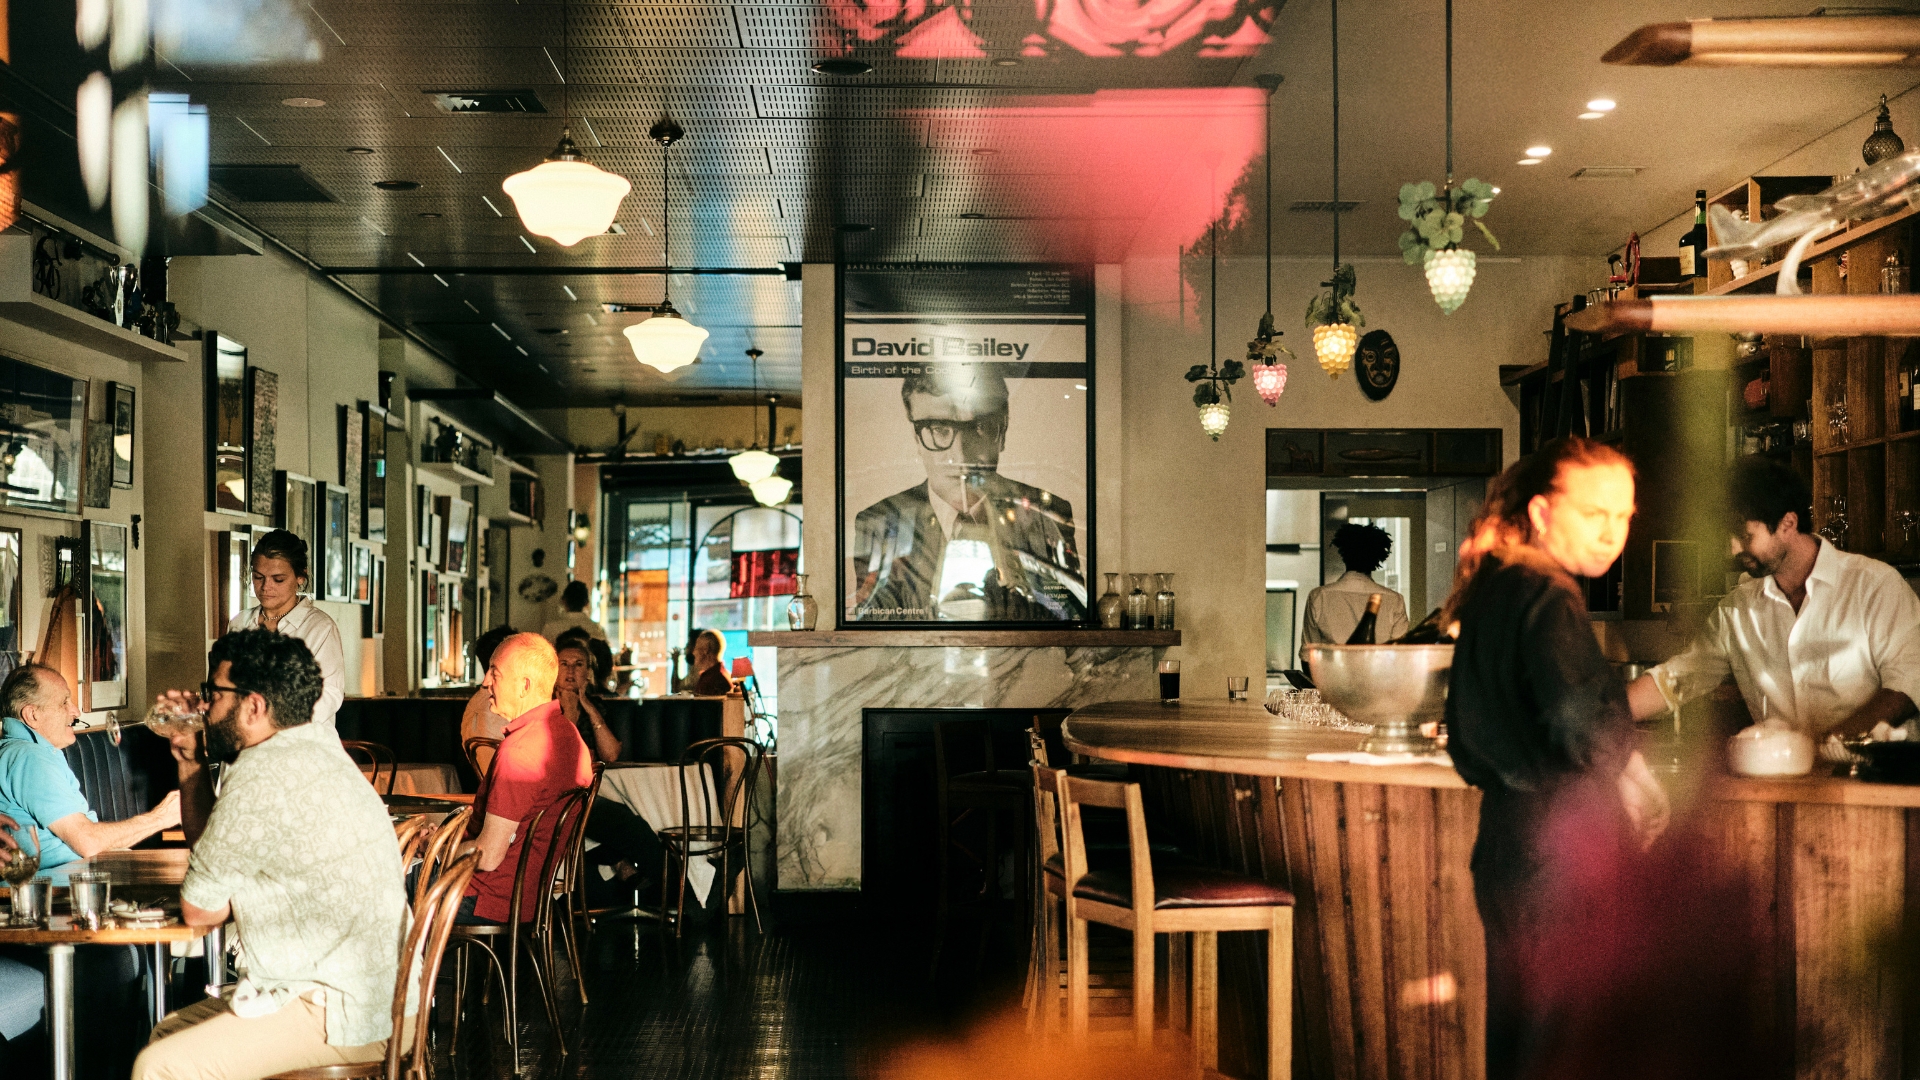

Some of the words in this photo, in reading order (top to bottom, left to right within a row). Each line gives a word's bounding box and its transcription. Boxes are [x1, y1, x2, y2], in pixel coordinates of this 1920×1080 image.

[851, 337, 935, 356] David
[942, 337, 1030, 361] Bailey
[851, 365, 881, 375] Birth
[884, 365, 898, 375] of
[901, 365, 921, 375] the
[925, 365, 951, 375] Coo
[858, 606, 896, 615] Barbican
[896, 606, 925, 615] Centre
